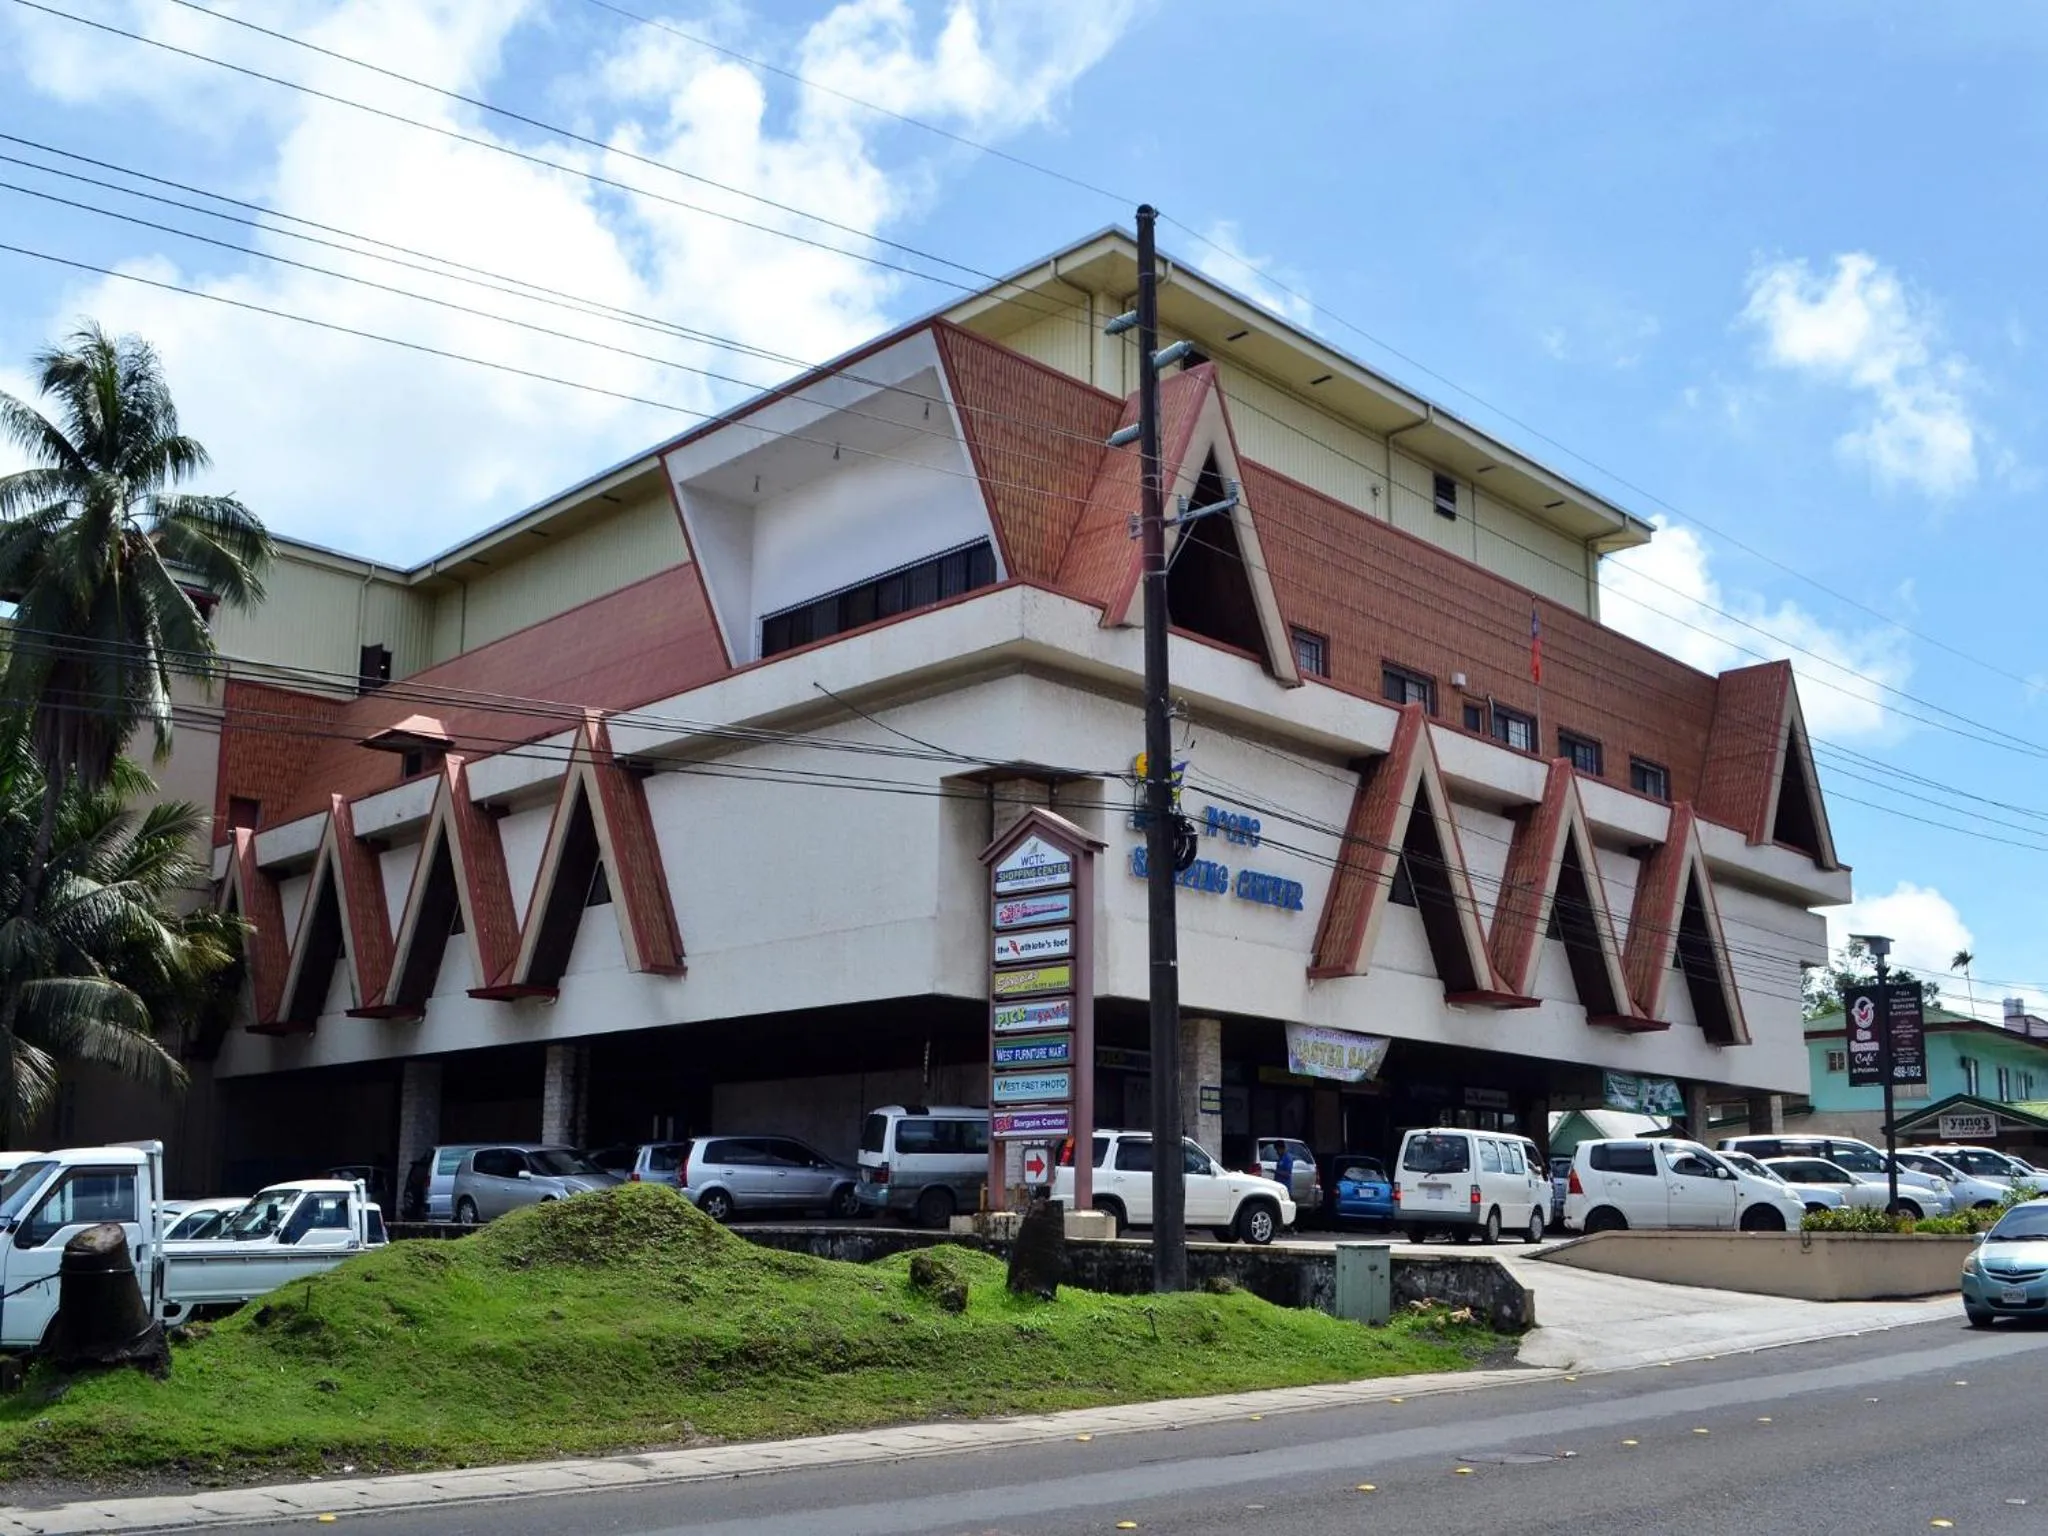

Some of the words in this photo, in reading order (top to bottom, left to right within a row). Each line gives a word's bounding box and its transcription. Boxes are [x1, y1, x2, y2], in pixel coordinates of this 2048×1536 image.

[1021, 854, 1045, 866] WCTC
[999, 866, 1036, 881] SHOPPING
[1038, 863, 1068, 876] CENTER
[997, 945, 1009, 954] the
[1053, 938, 1068, 948] foot
[996, 1049, 1013, 1061] WEST
[1015, 1047, 1048, 1060] FURNITURE
[1049, 1044, 1066, 1057] MART
[997, 1080, 1020, 1092] WEST
[1021, 1081, 1039, 1090] FAST
[1040, 1079, 1067, 1089] PHOTO
[1014, 1119, 1040, 1129] Bargain
[1041, 1117, 1066, 1126] Center
